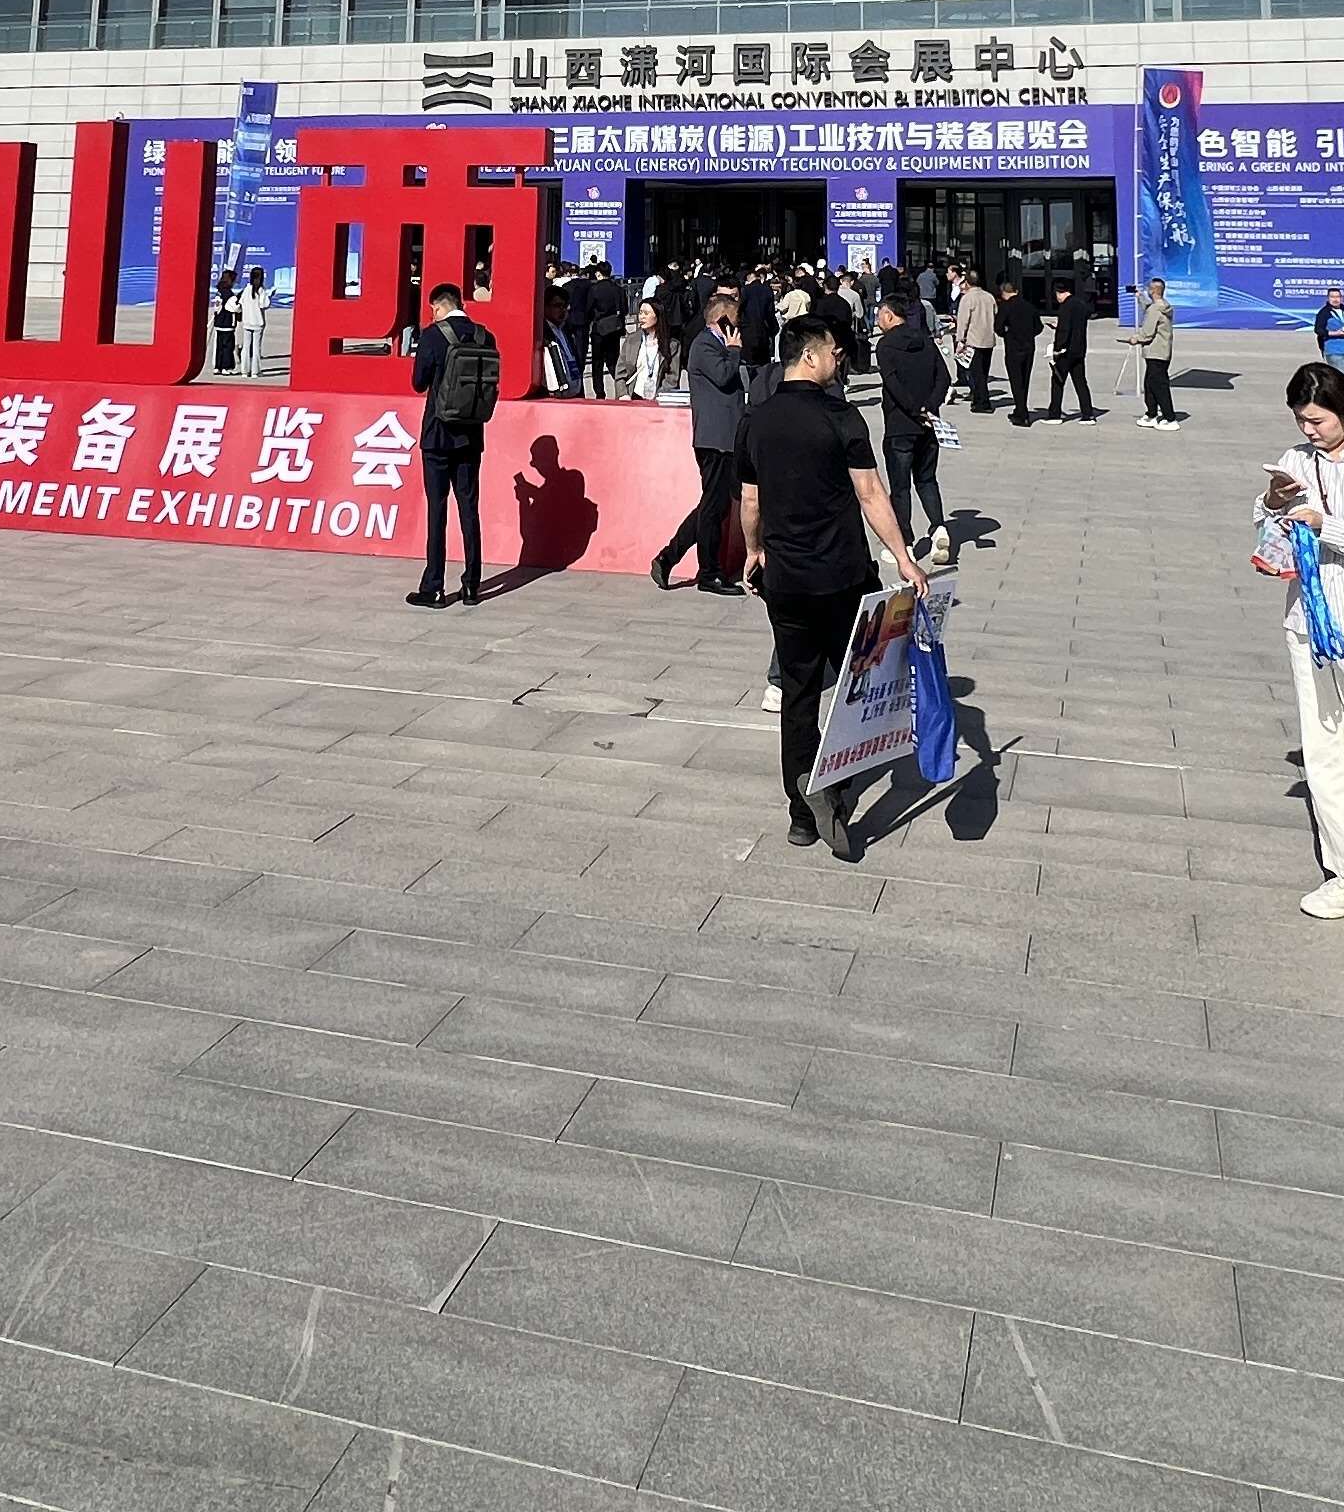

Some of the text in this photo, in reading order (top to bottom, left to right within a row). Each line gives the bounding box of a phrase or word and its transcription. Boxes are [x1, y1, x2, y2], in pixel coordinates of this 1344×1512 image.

[512, 37, 1084, 90] 山西潇河国际会展中心
[510, 87, 1089, 113] SHANXI XIAOHE INTERNATIONAL CONVENTION & EXHIBITION CENTER
[552, 119, 1089, 157] 三届太原煤炭(能源)工业技术与装备展览会
[311, 166, 346, 176] FUURE
[594, 158, 631, 172] COAL
[635, 156, 700, 174] (ENERGY)
[704, 157, 777, 172] INDUSTRY
[780, 156, 883, 172] TECHNOLOGY
[886, 156, 897, 171] &
[901, 155, 993, 173] EQUIPMENT
[997, 154, 1090, 170] EXHIBITION
[1238, 161, 1248, 172] A
[1251, 161, 1291, 172] GREEN
[1295, 161, 1321, 172] AND
[126, 488, 400, 540] EXHIBITION
